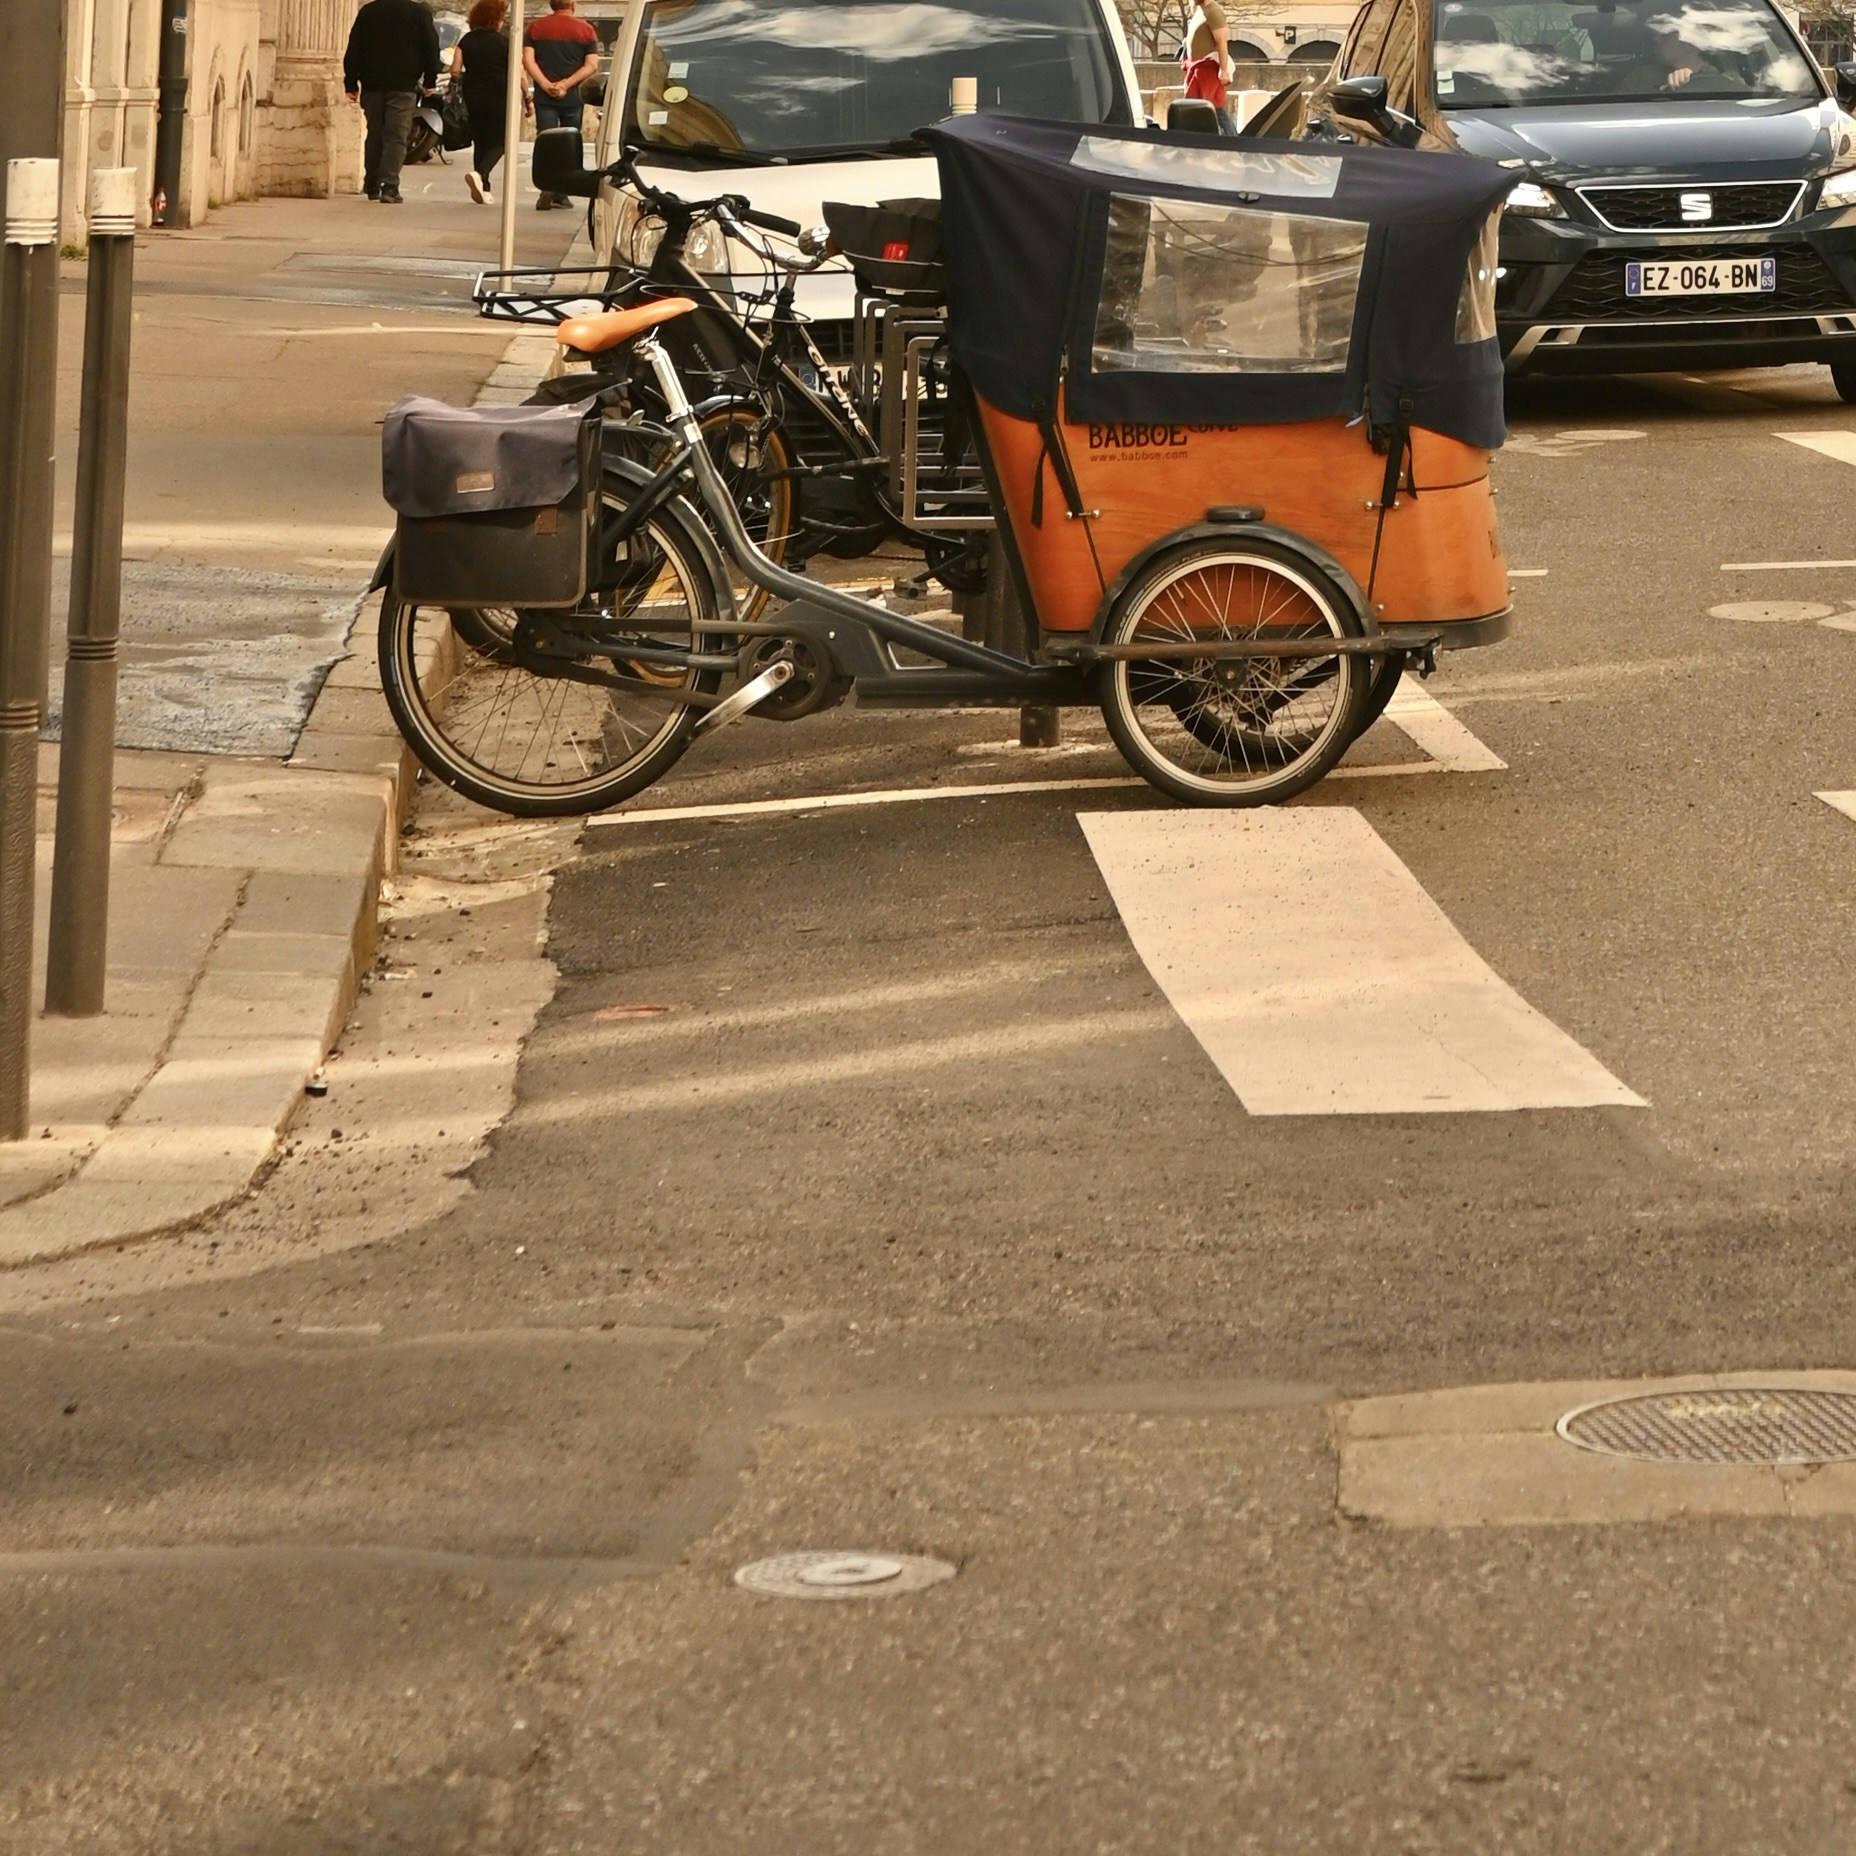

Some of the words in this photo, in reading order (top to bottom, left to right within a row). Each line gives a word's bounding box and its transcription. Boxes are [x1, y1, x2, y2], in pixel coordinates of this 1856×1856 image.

[1643, 264, 1758, 291] EZ-064-BN
[1089, 422, 1188, 449] BABBOE
[1090, 450, 1188, 462] www.babboe.com
